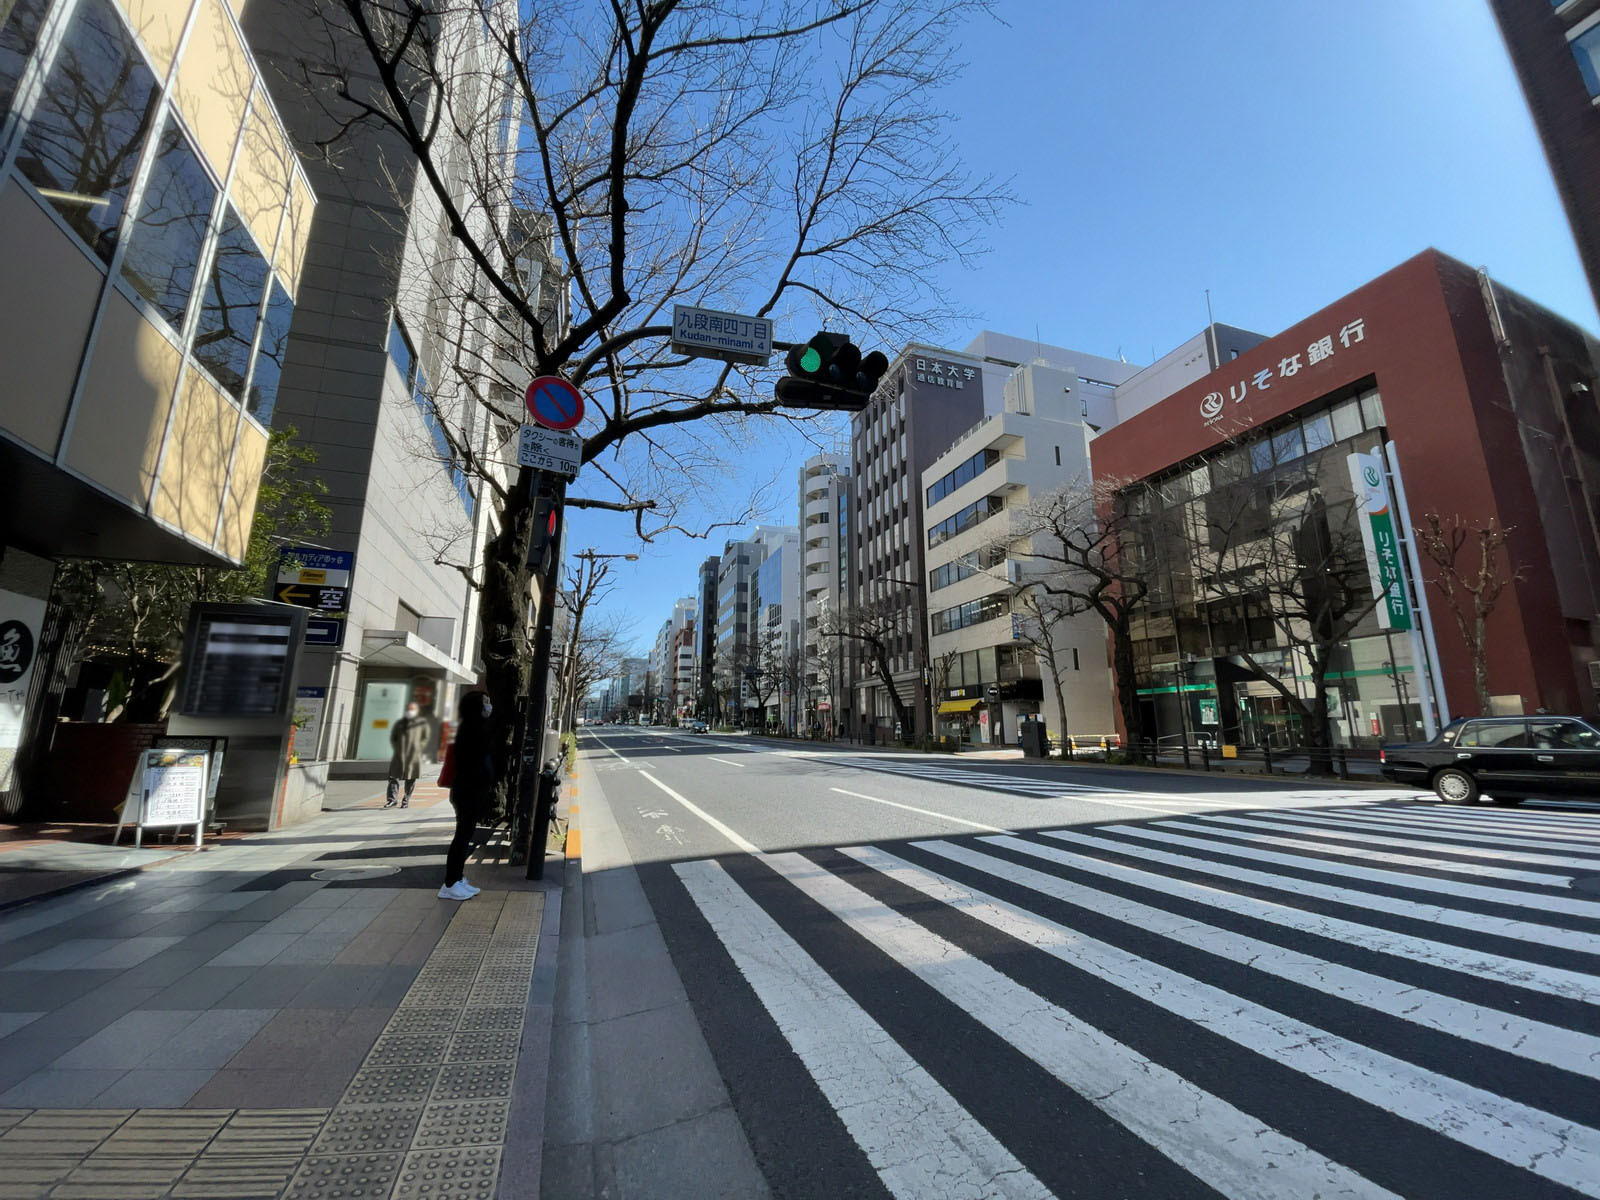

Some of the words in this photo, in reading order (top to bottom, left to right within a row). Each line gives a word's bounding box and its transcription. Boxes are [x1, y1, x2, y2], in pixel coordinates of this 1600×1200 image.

[678, 311, 767, 340] 九段南四丁目
[680, 329, 754, 350] Kudan-minami
[758, 342, 765, 351] 4
[916, 359, 976, 381] 日本大学
[1229, 318, 1365, 404] りそな銀行
[522, 442, 550, 455] を除く
[523, 429, 579, 451] タクシーの客待ち
[521, 452, 553, 468] ここから
[560, 460, 578, 474] 10m
[317, 587, 344, 609] 空
